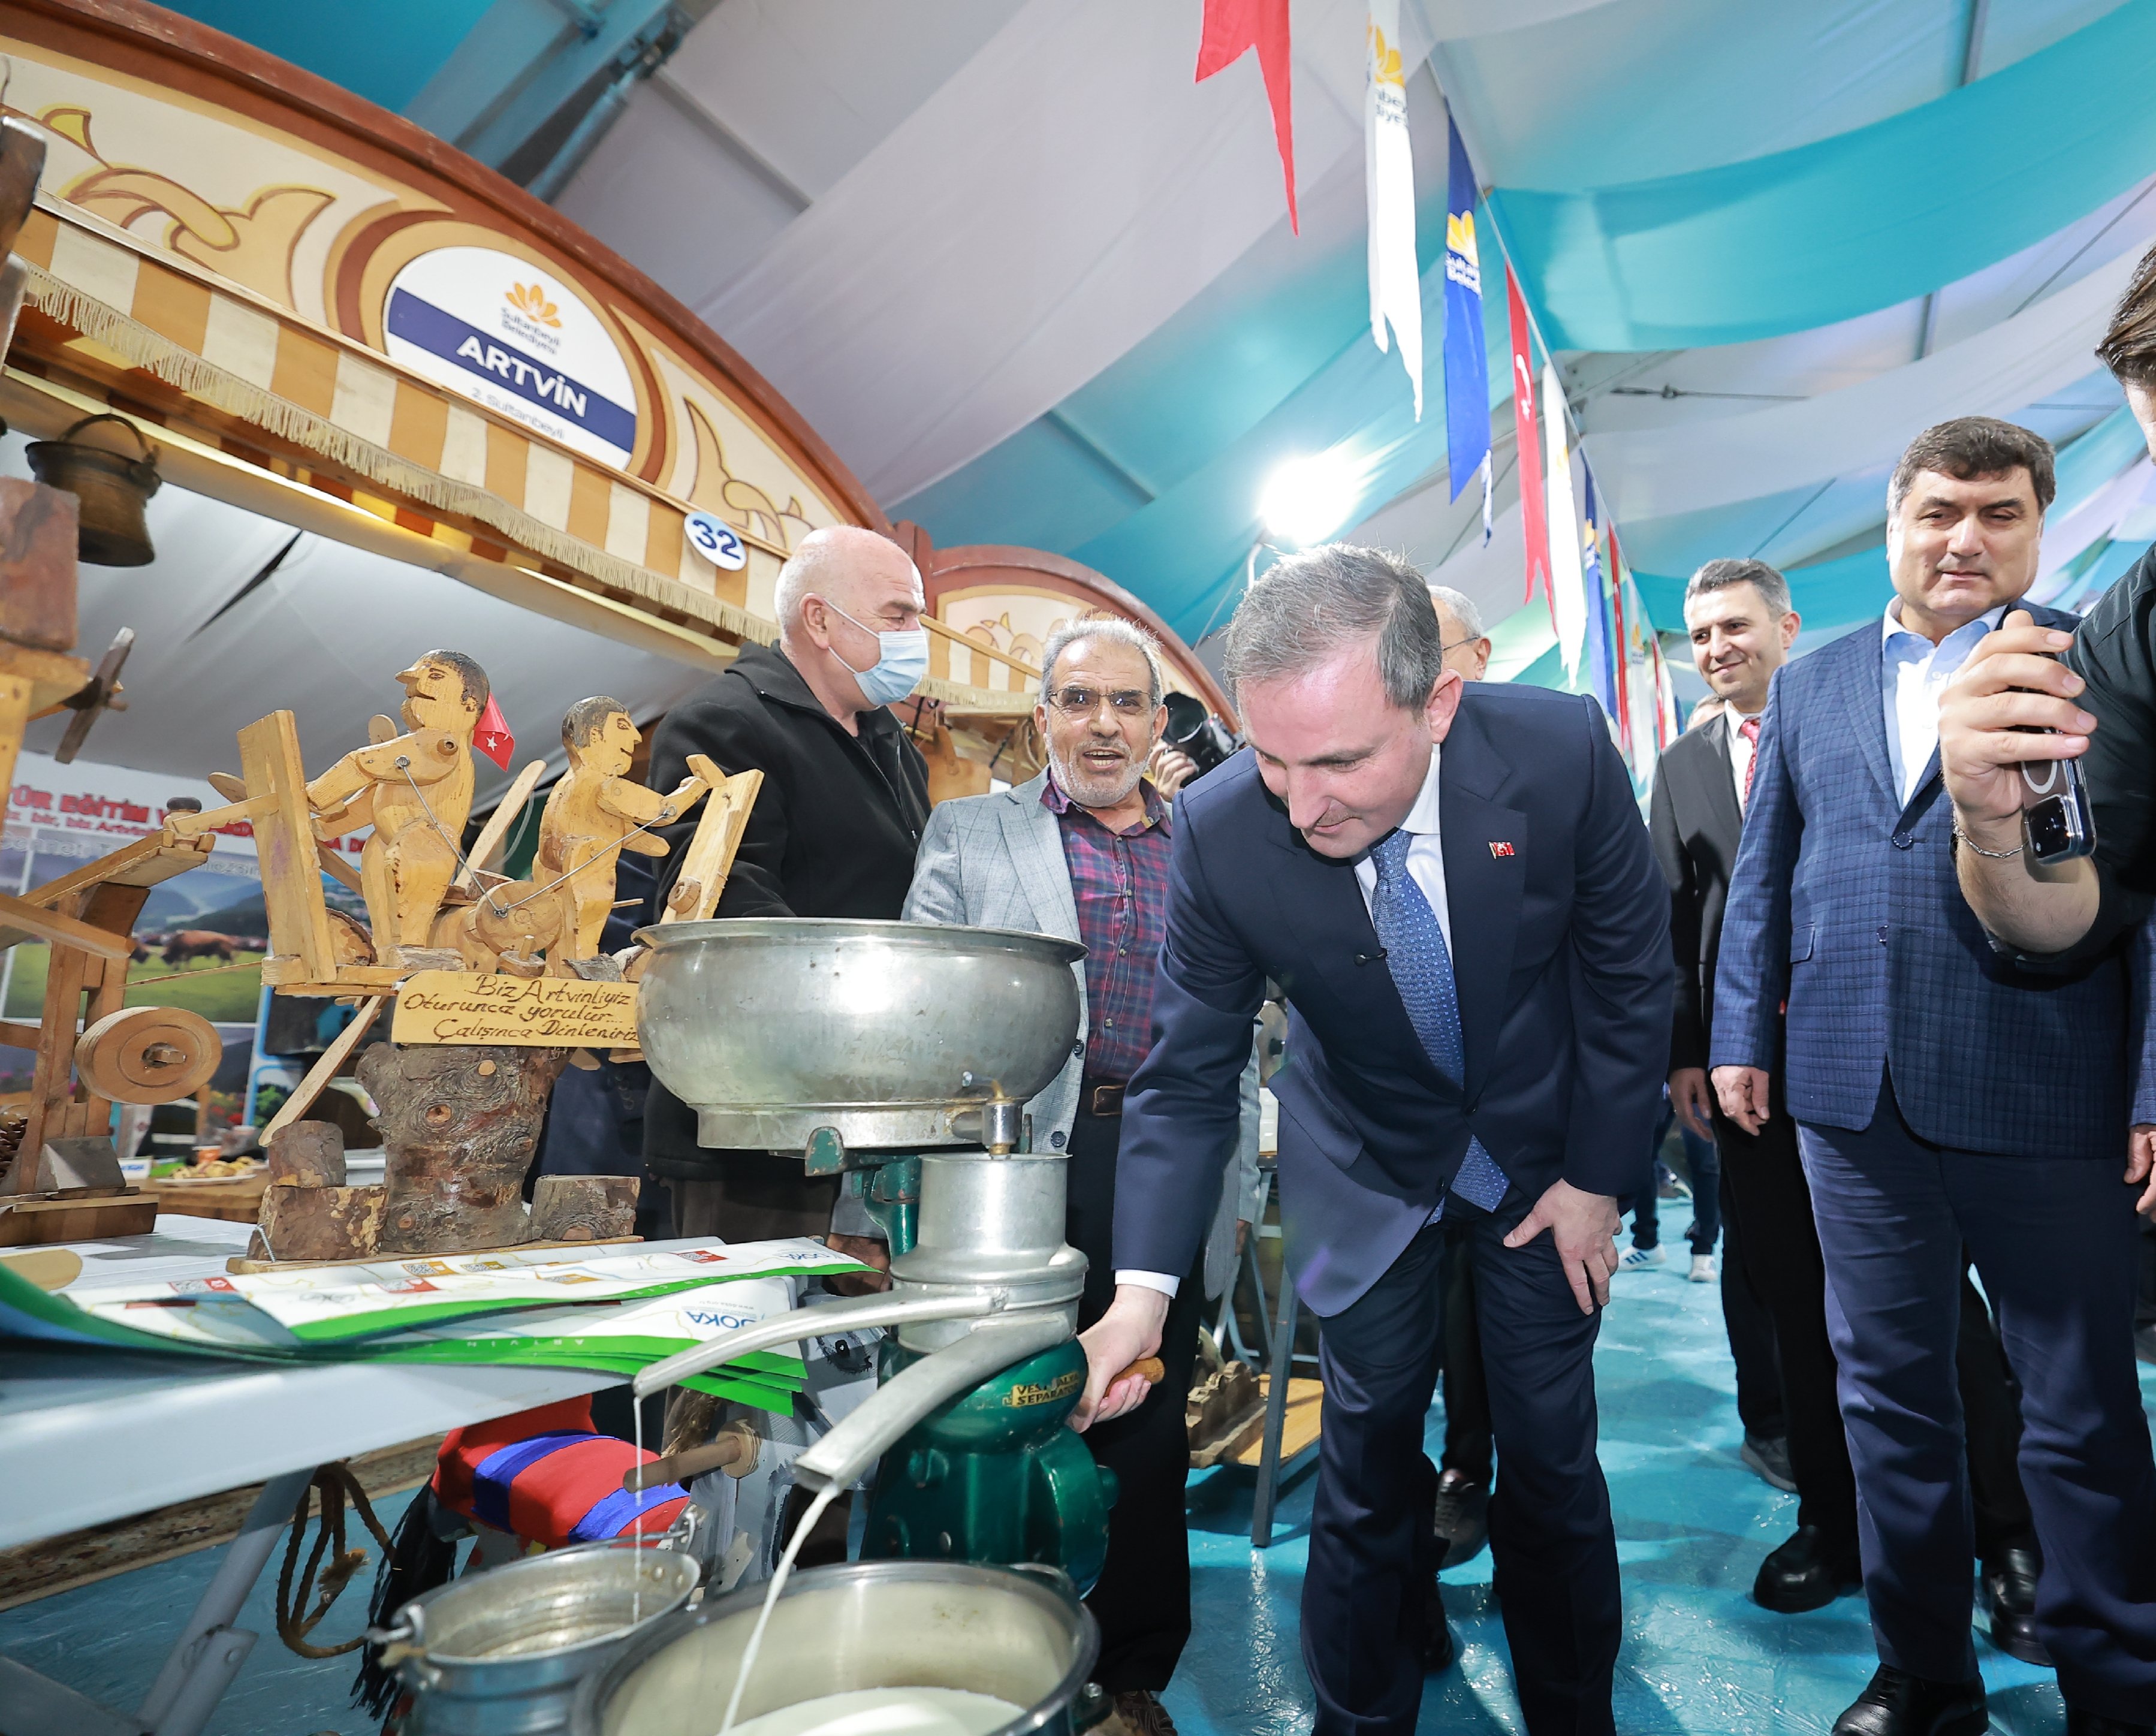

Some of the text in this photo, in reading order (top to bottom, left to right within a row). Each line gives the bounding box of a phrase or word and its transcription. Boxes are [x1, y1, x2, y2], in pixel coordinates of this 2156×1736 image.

[456, 335, 587, 418] ARTVİN
[487, 393, 565, 439] Sultanbeyli
[693, 520, 741, 560] 32
[10, 784, 52, 809] ÜR
[404, 993, 516, 1015] Oturunca
[464, 974, 631, 1009] Biz Artvinliyiz
[433, 1019, 639, 1042] Çalışınca Dinleniriz
